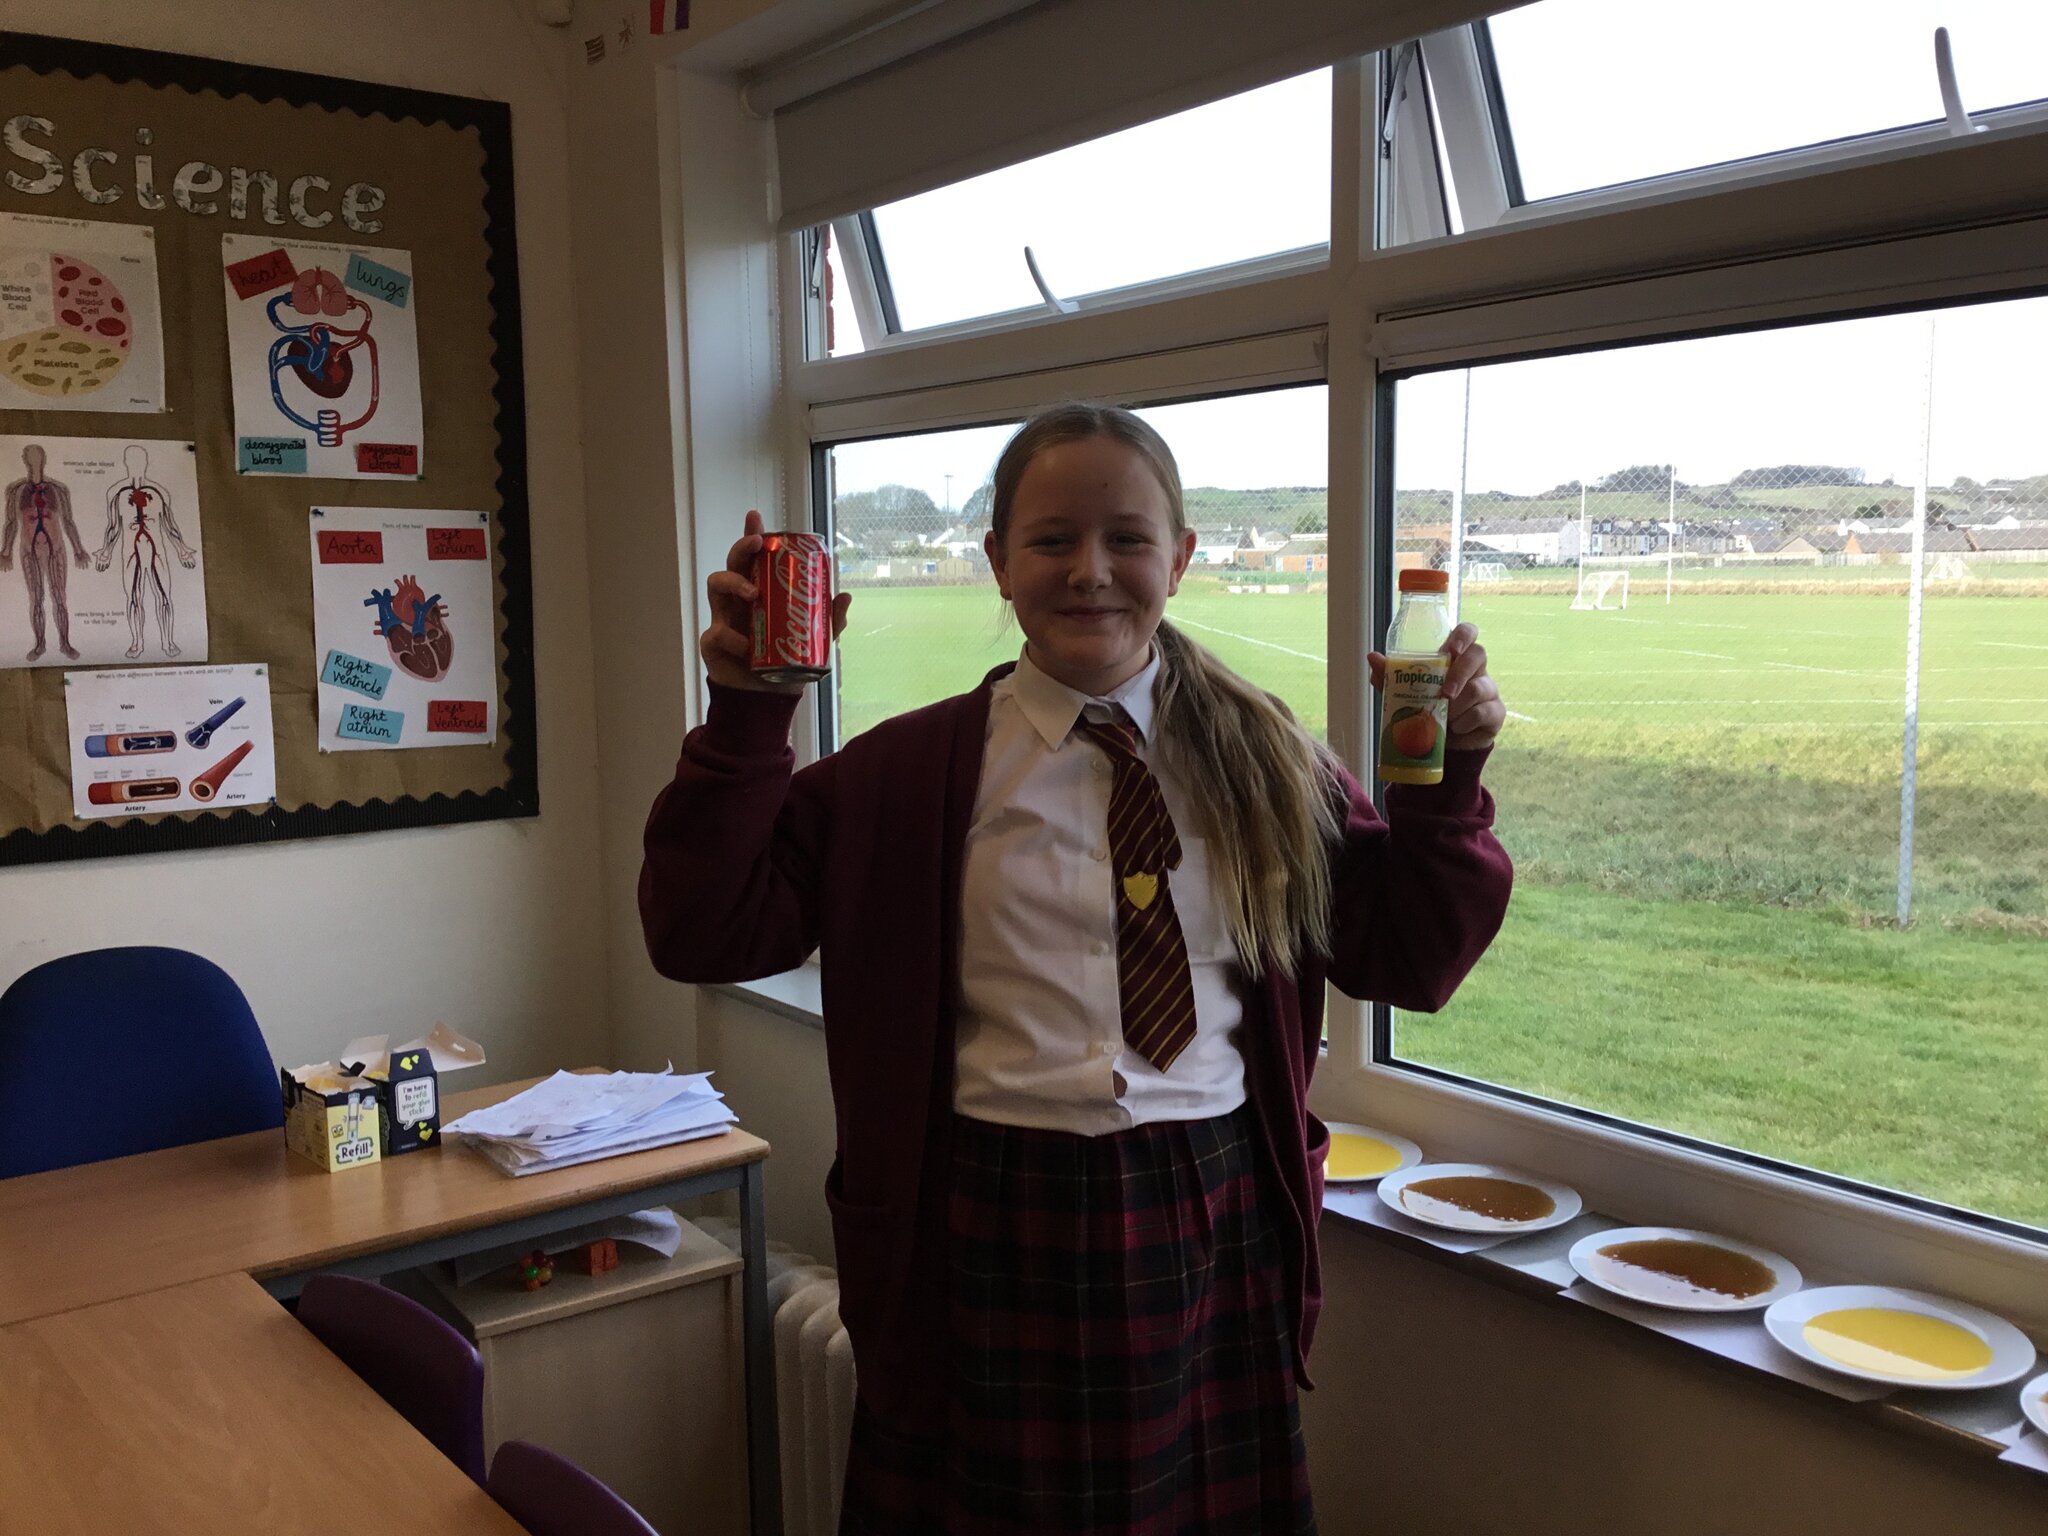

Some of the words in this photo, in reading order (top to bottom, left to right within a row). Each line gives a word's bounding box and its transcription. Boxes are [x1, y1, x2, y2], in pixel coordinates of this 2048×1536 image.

[2, 114, 387, 234] Science
[236, 256, 288, 286] heart
[356, 261, 405, 300] lungs
[1, 284, 31, 293] White
[78, 289, 98, 297] Red
[2, 293, 32, 302] Blood
[75, 297, 103, 306] Blood
[7, 302, 28, 311] Cell
[80, 306, 100, 314] Cell
[34, 359, 80, 369] Platelets
[244, 439, 306, 455] deoxygenated
[252, 453, 283, 465] blood
[326, 535, 378, 556] Aorta
[334, 654, 373, 680] Right
[332, 669, 382, 696] ventricle
[1394, 669, 1443, 687] Tropicana
[120, 703, 135, 711] Vein
[208, 698, 224, 706] Vein
[349, 705, 387, 726] Right
[346, 720, 391, 738] atrium
[226, 792, 246, 801] Artery
[124, 804, 146, 813] Artery
[402, 1086, 413, 1094] I'm
[413, 1084, 428, 1092] here
[404, 1094, 412, 1102] to
[401, 1101, 416, 1111] your
[417, 1098, 431, 1108] glue
[341, 1142, 369, 1159] Refill
